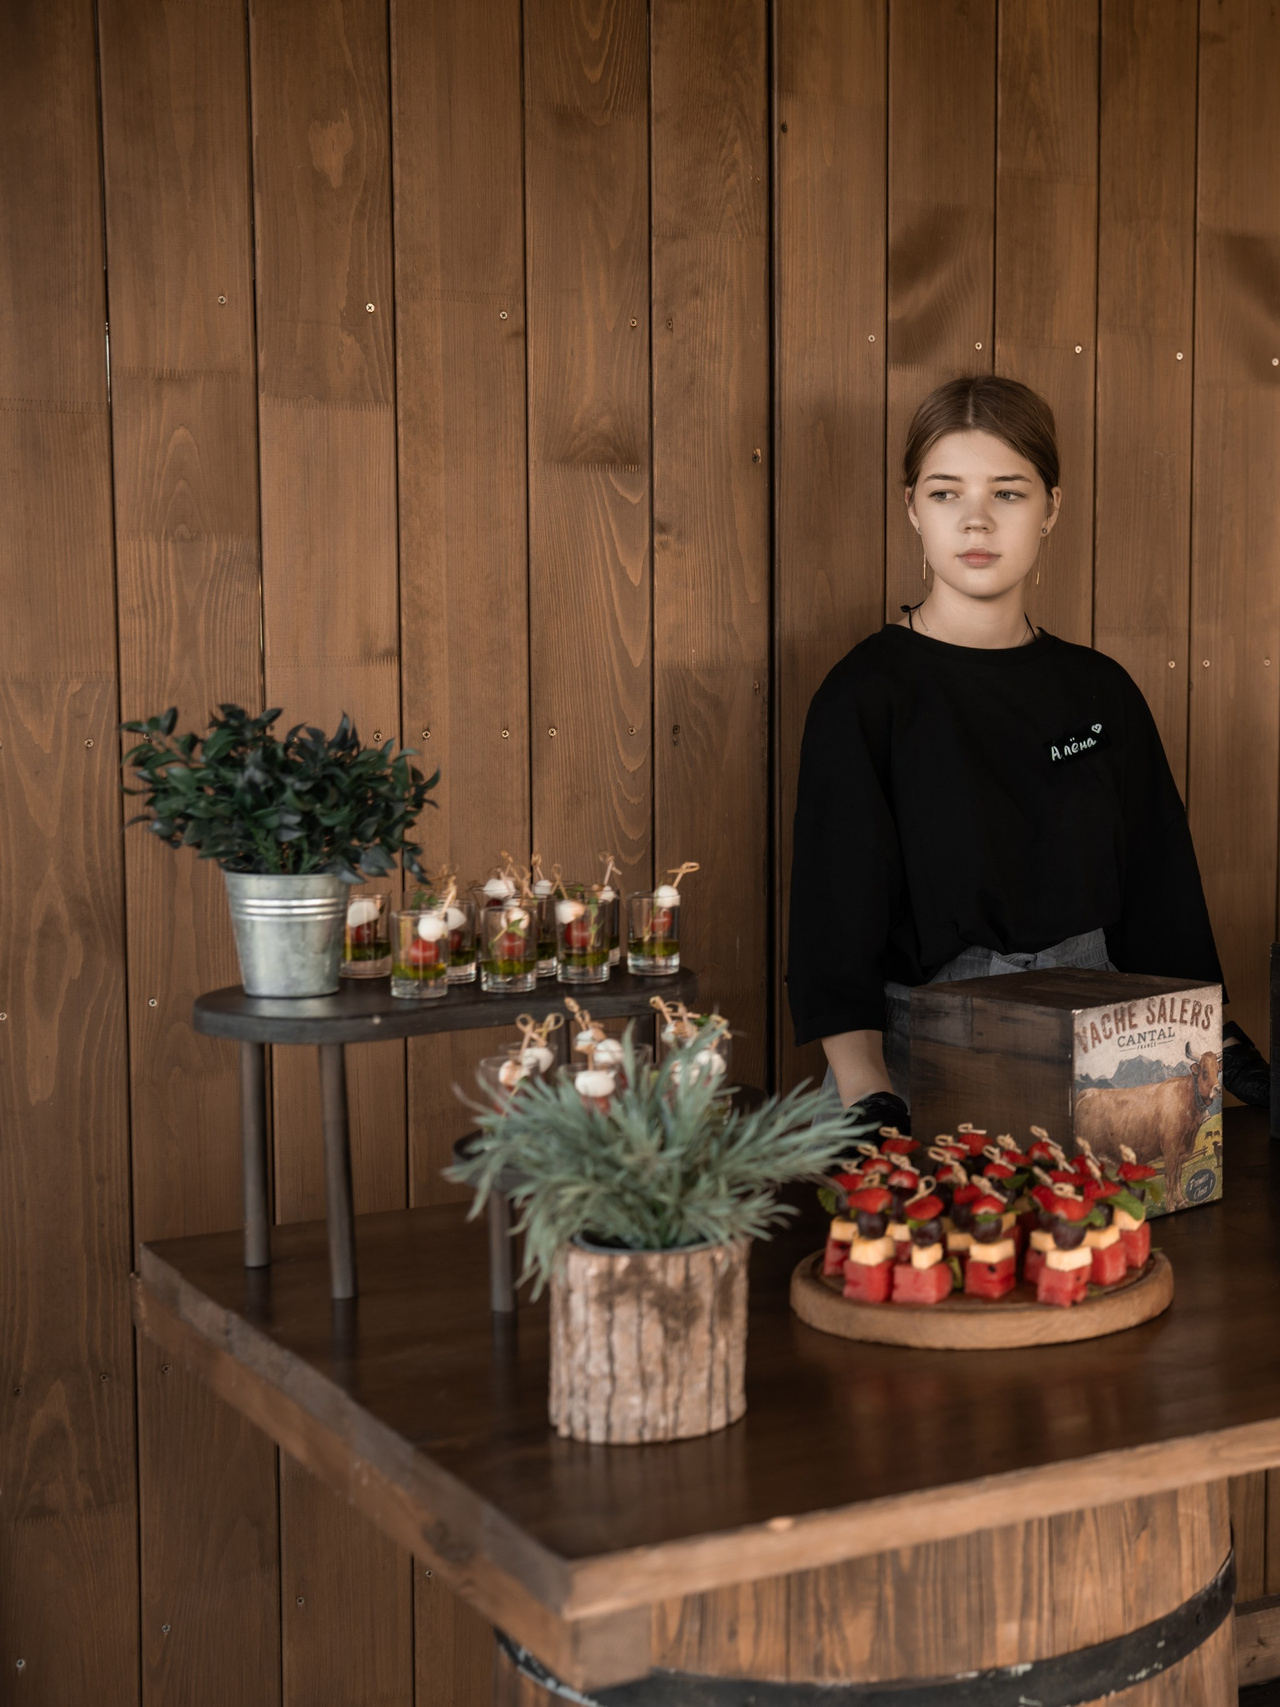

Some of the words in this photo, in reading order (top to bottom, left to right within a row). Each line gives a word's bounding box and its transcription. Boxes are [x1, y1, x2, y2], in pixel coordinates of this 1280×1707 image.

[1050, 737, 1097, 761] Алёна
[1075, 1002, 1138, 1054] VACHE
[1145, 997, 1214, 1031] SALERS
[1117, 1026, 1176, 1048] CANTAL
[1137, 1042, 1157, 1050] FRANCE
